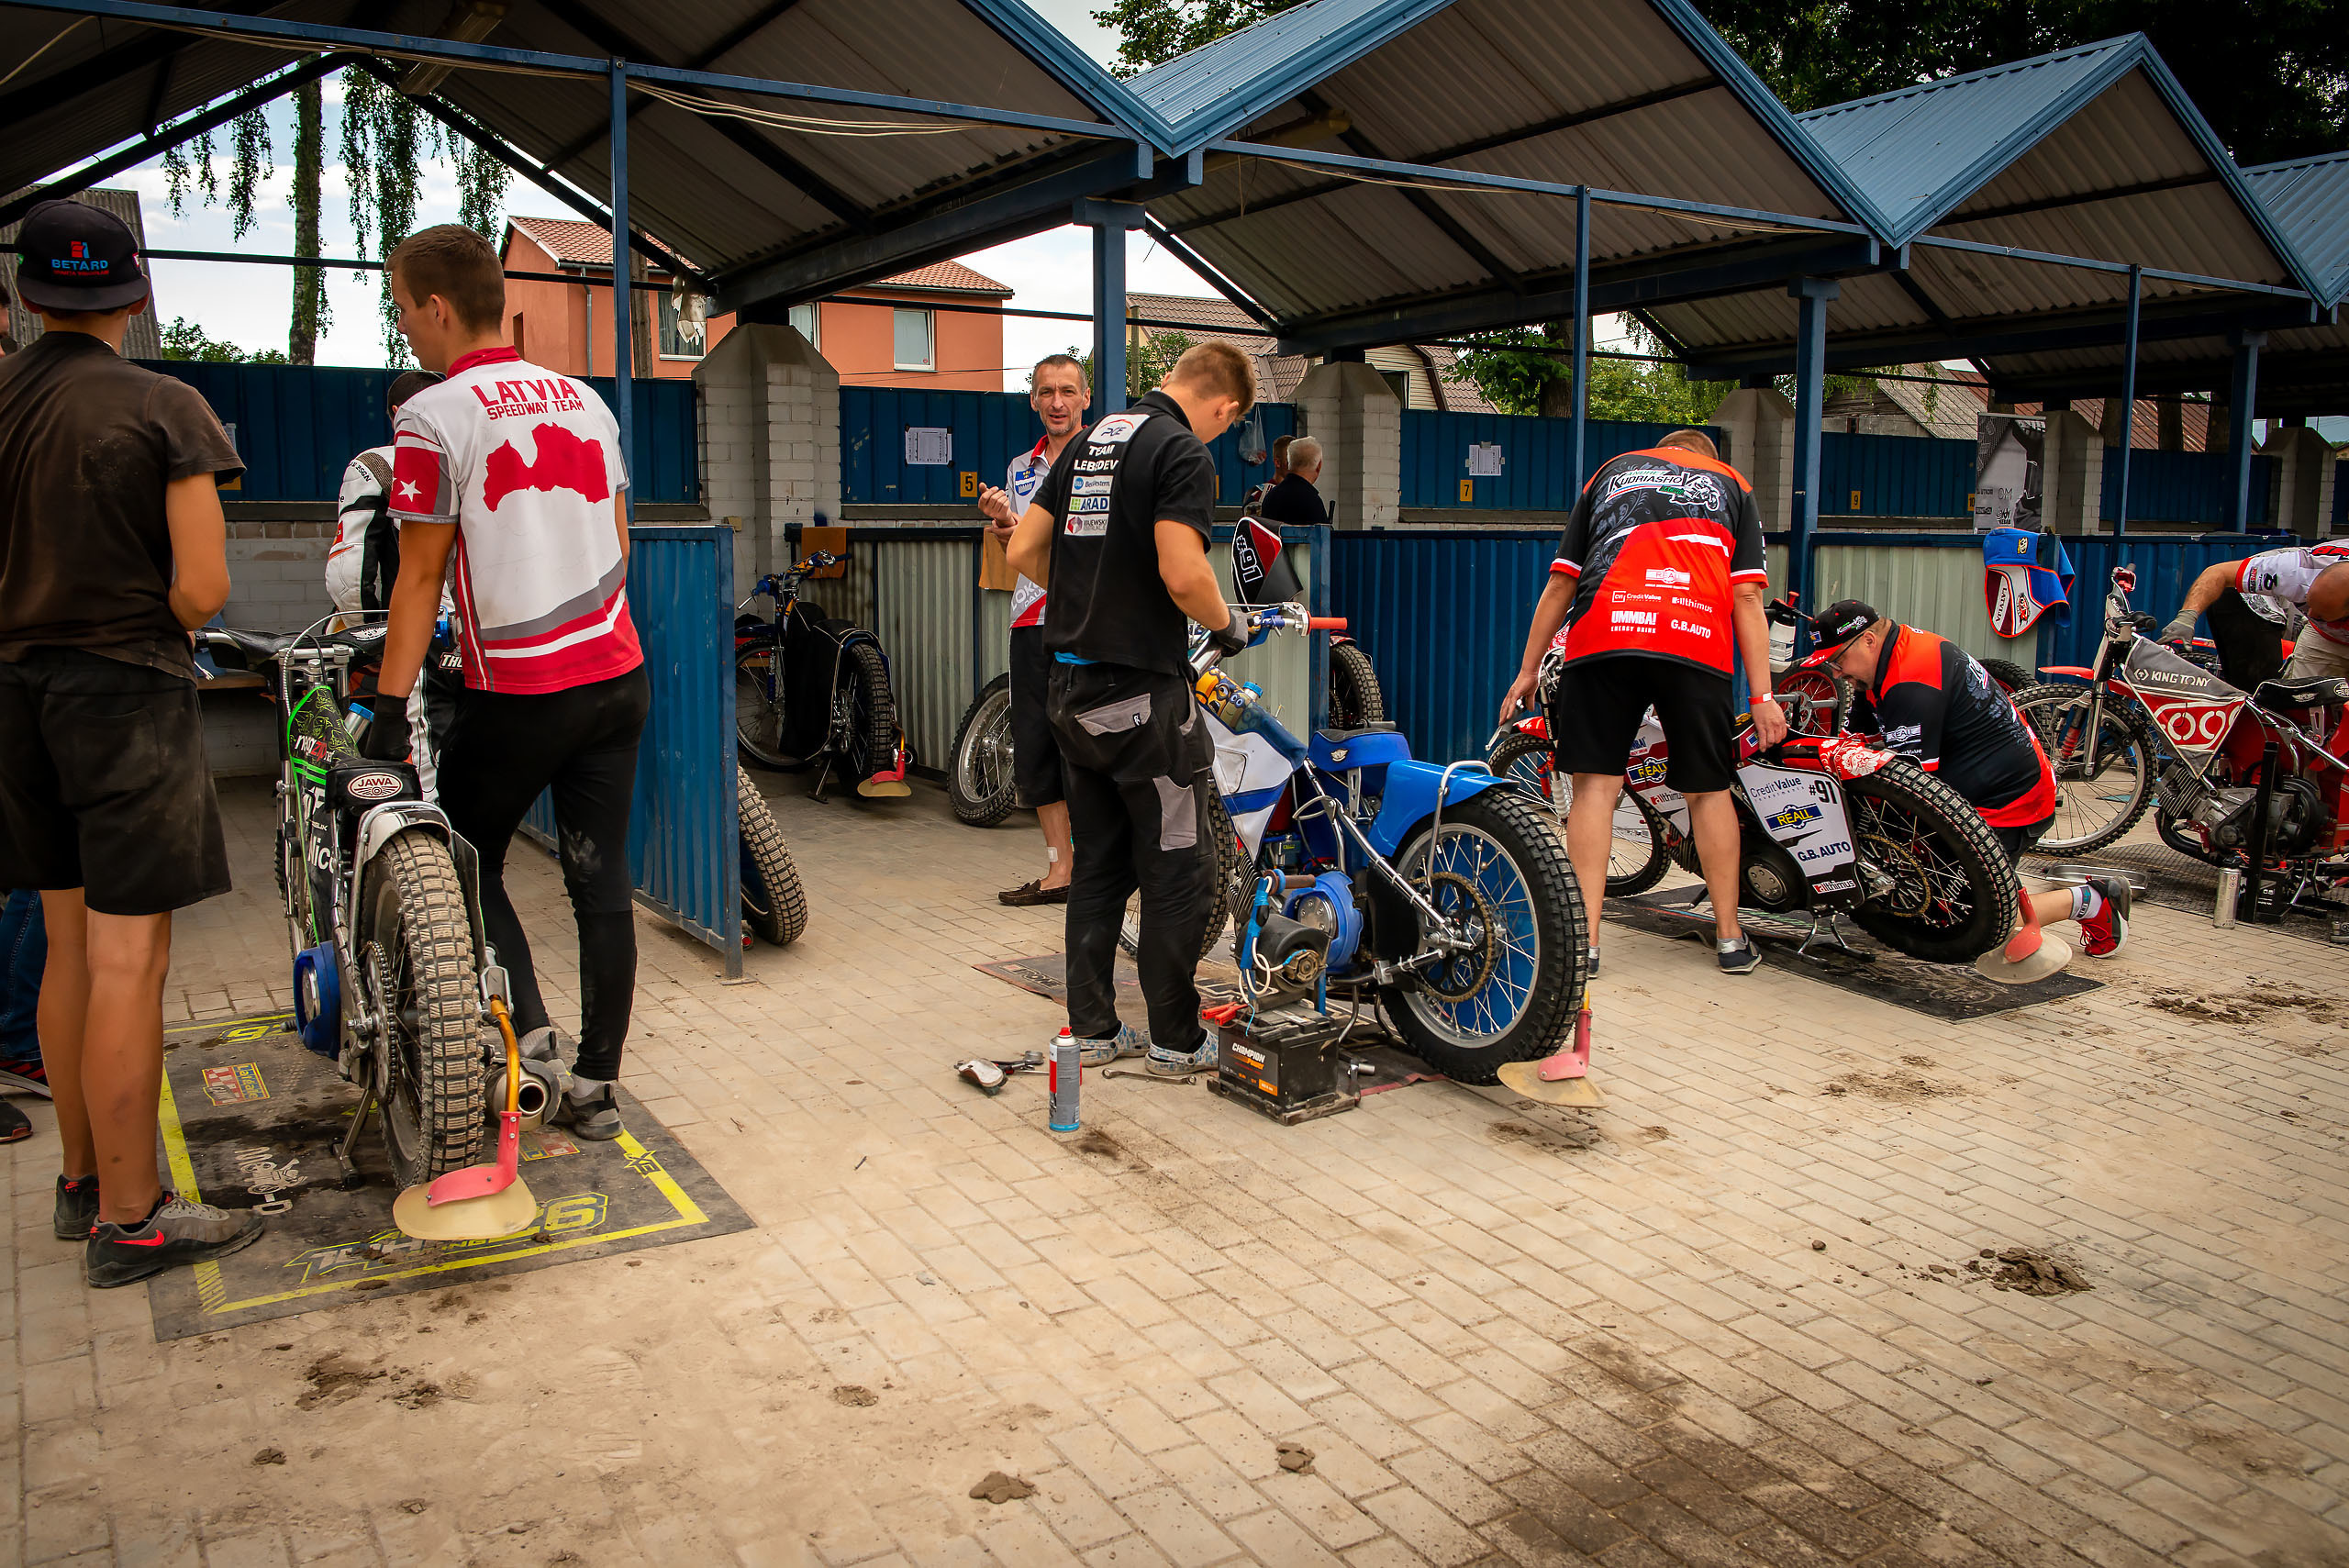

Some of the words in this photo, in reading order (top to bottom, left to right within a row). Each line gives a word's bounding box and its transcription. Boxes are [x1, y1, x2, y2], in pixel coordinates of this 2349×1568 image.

[51, 259, 109, 271] BETARD
[471, 378, 580, 407] LATVIA
[486, 401, 549, 421] SPEEDWAY
[551, 399, 585, 412] TEAM
[1088, 444, 1116, 457] TEAM
[964, 475, 974, 492] 5
[1464, 484, 1470, 497] 7
[1080, 497, 1108, 511] ARAD
[1236, 535, 1264, 584] #91
[1611, 610, 1657, 626] UMMBA!
[2151, 670, 2179, 684] KING
[2179, 674, 2211, 687] TONY
[358, 778, 393, 787] JAWA
[1809, 780, 1838, 805] #91
[1776, 809, 1813, 825] REALL
[1231, 1042, 1266, 1064] CHAMPION
